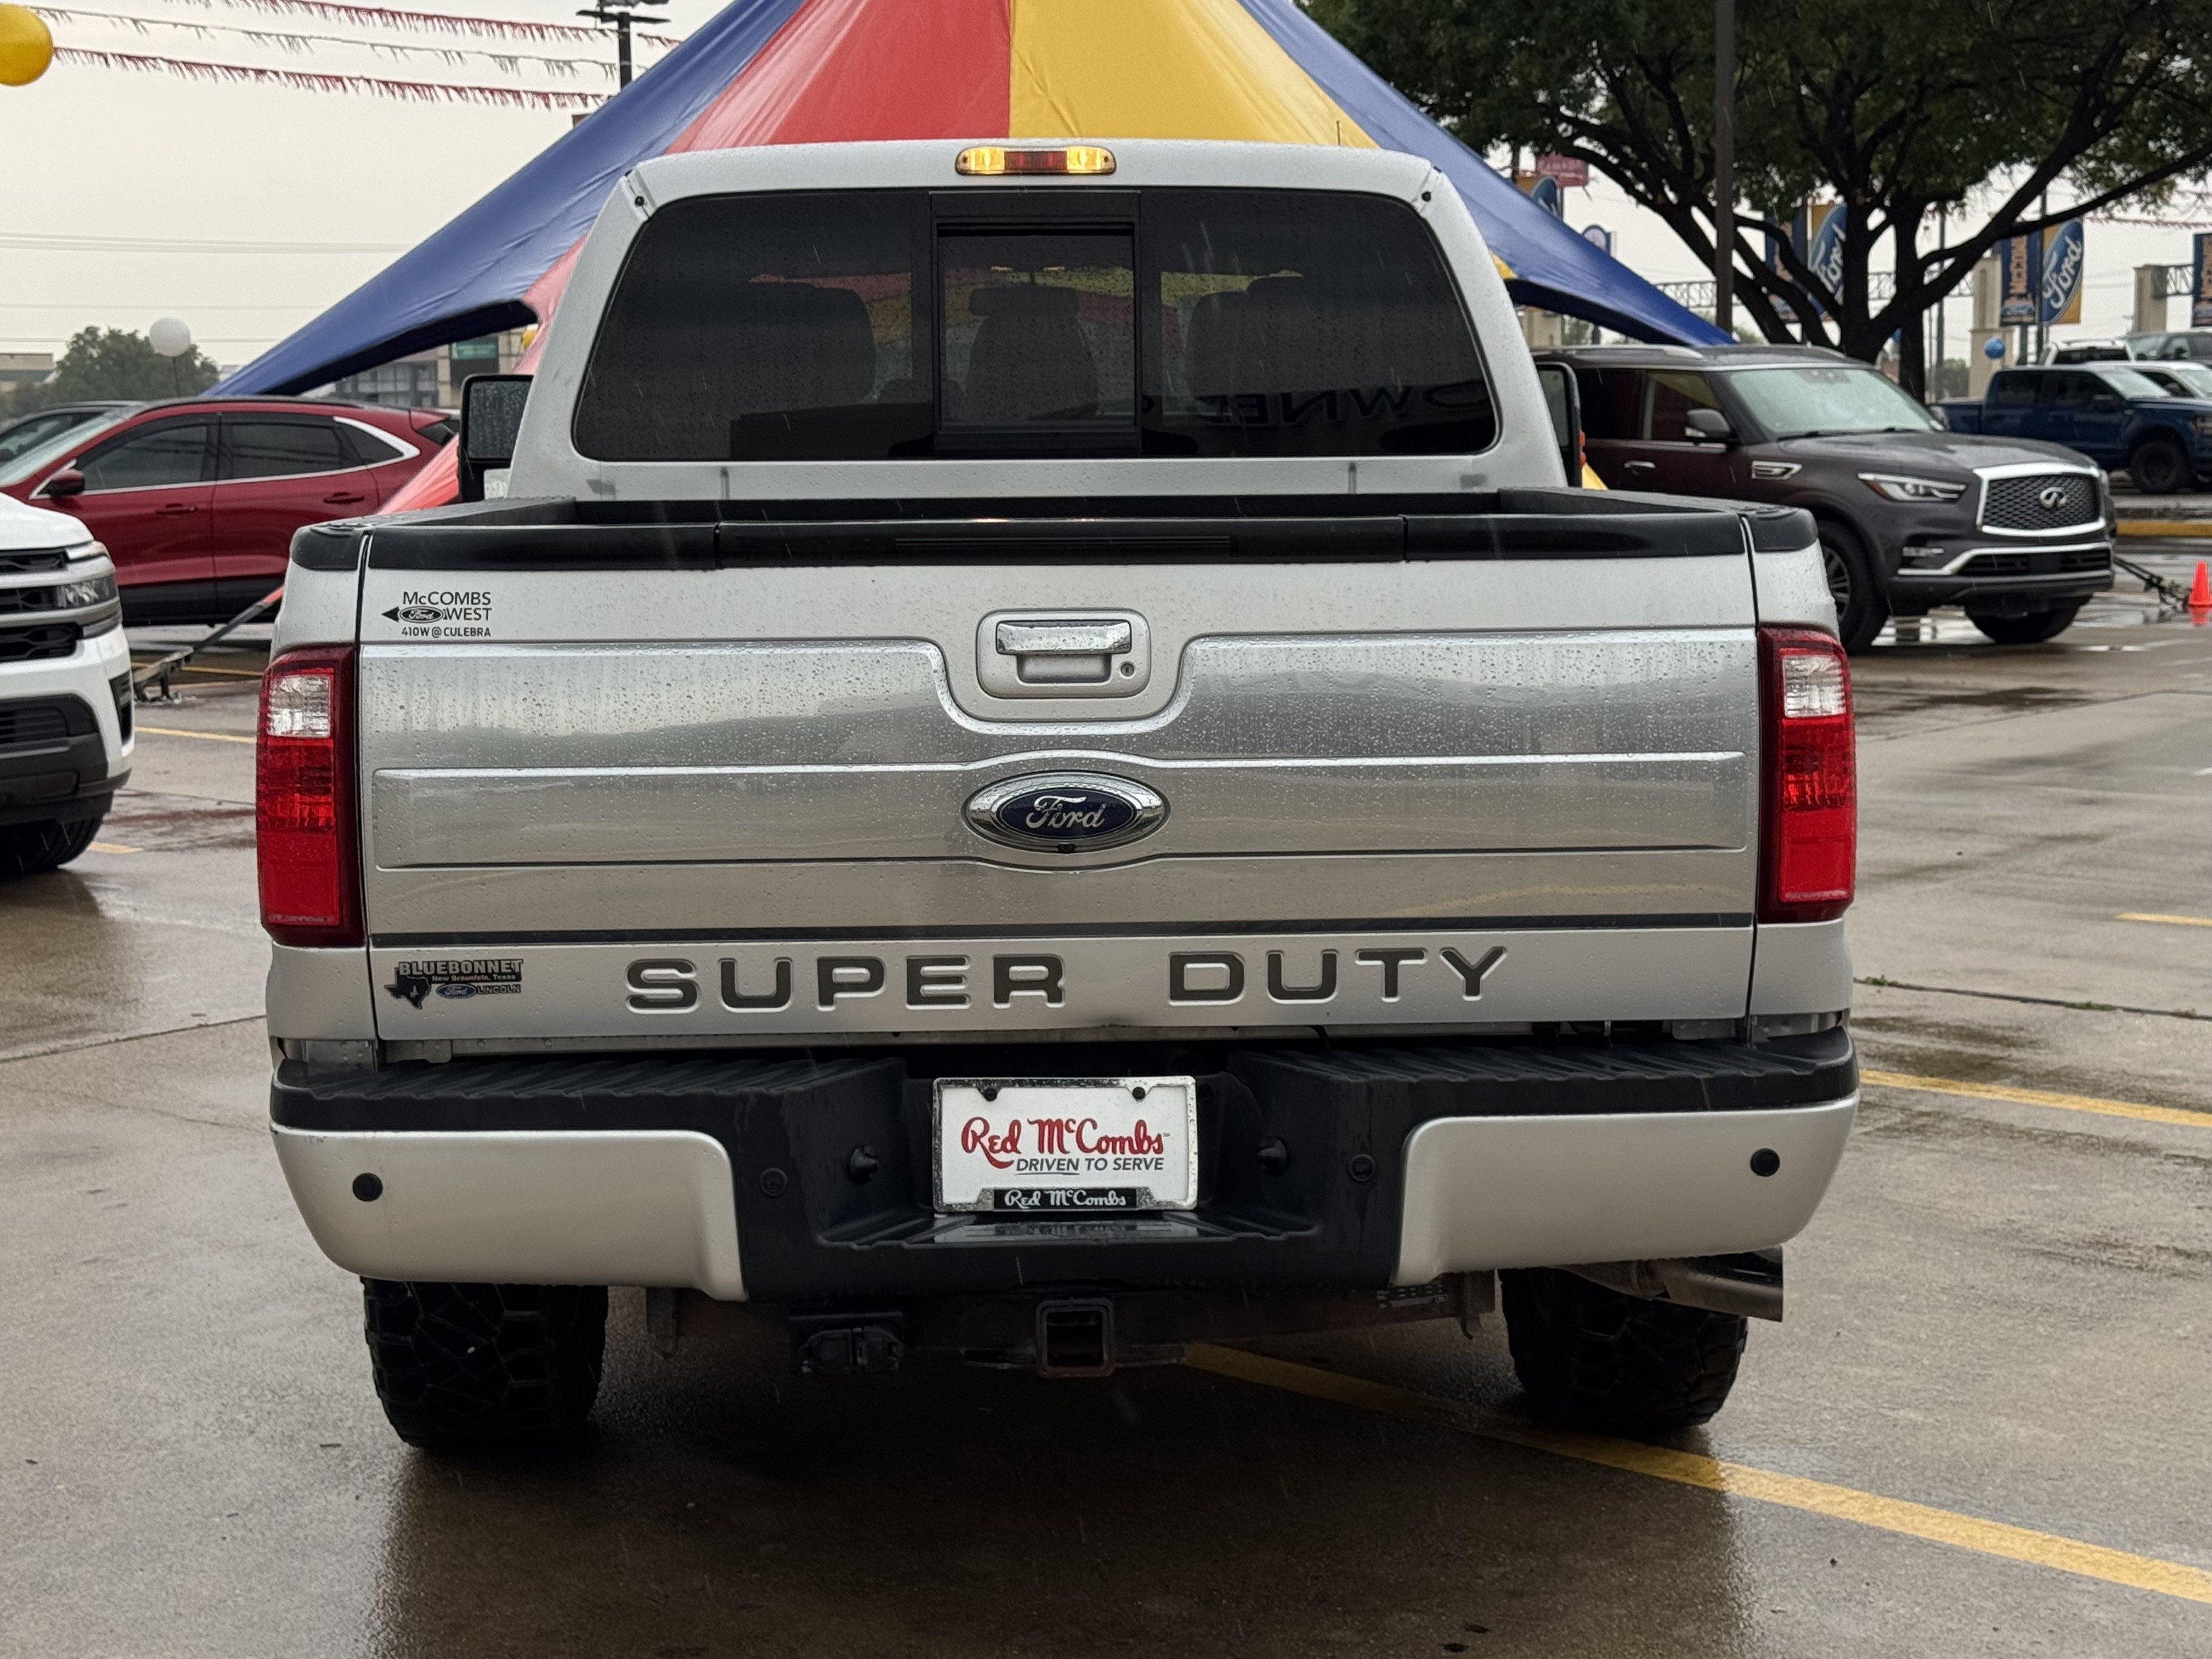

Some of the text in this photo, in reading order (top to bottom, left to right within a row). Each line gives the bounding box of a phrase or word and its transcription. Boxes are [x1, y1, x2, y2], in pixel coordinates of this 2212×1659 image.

[2041, 235, 2082, 309] Ford
[403, 591, 492, 606] McCOMBS
[408, 607, 493, 621] Ford WEST
[1025, 795, 1107, 830] Ford
[399, 960, 522, 975] BLUEBONNET
[625, 946, 1508, 1014] SUPER DUTY
[444, 984, 521, 996] Ford LINCOLN
[961, 1116, 1164, 1170] Red McCombs
[1015, 1156, 1165, 1172] DRIVEN TO SERVE
[1004, 1189, 1127, 1209] Red McCombs
